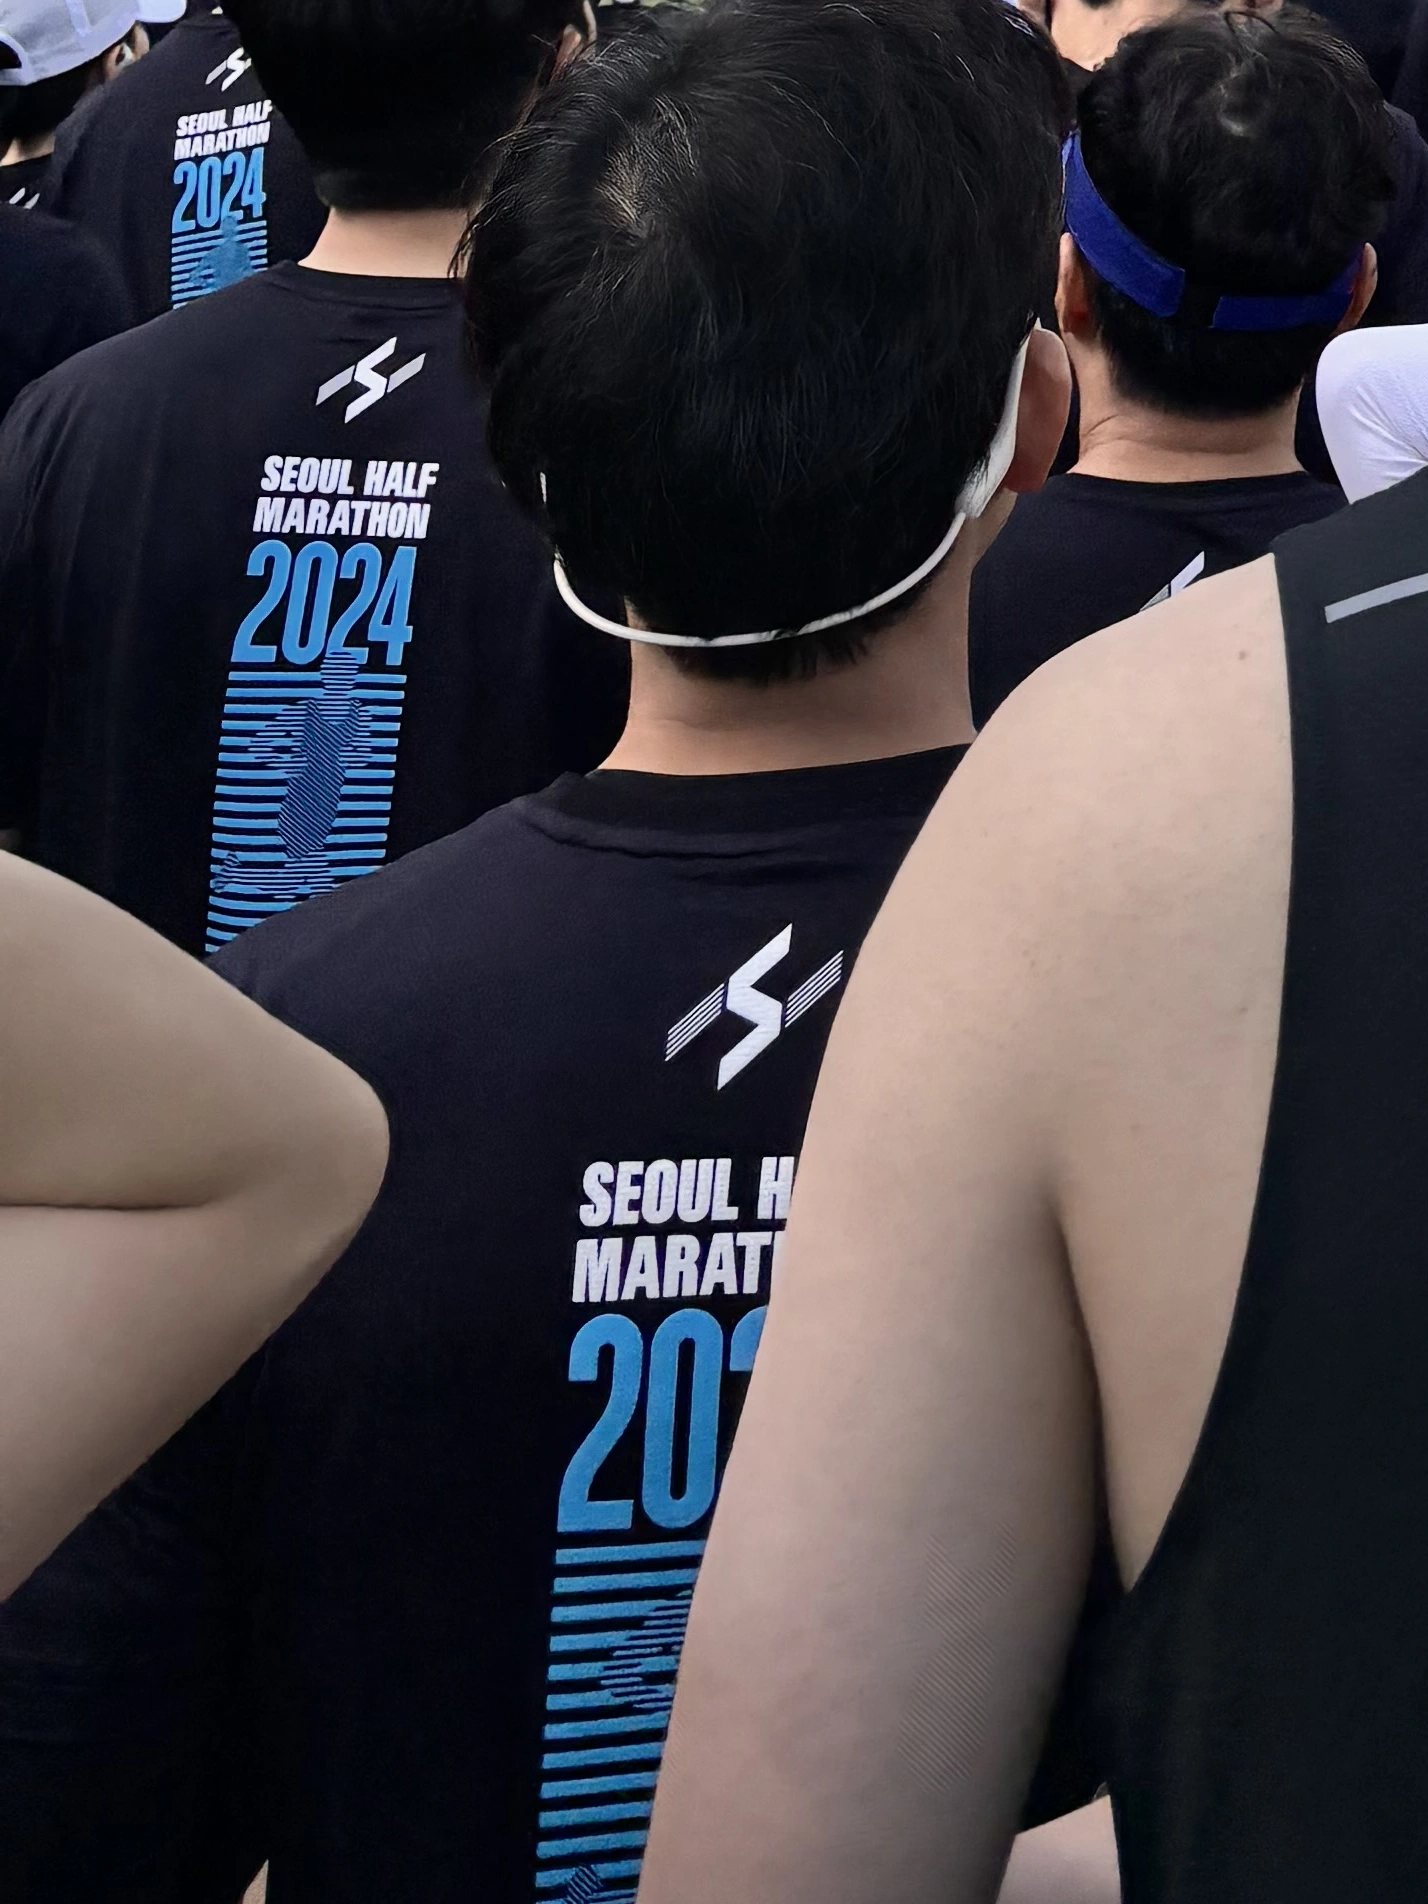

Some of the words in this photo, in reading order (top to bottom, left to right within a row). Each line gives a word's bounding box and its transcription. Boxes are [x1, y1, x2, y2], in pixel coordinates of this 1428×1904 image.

[176, 108, 228, 137] SEOUL
[232, 98, 273, 128] HALF
[173, 120, 271, 161] MARATHON
[171, 146, 267, 235] 2024
[260, 455, 354, 495] SEOUL
[363, 460, 440, 498] HALF
[252, 496, 431, 539] MARATHON
[230, 539, 418, 666] 2024
[579, 1157, 739, 1227] SEOUL
